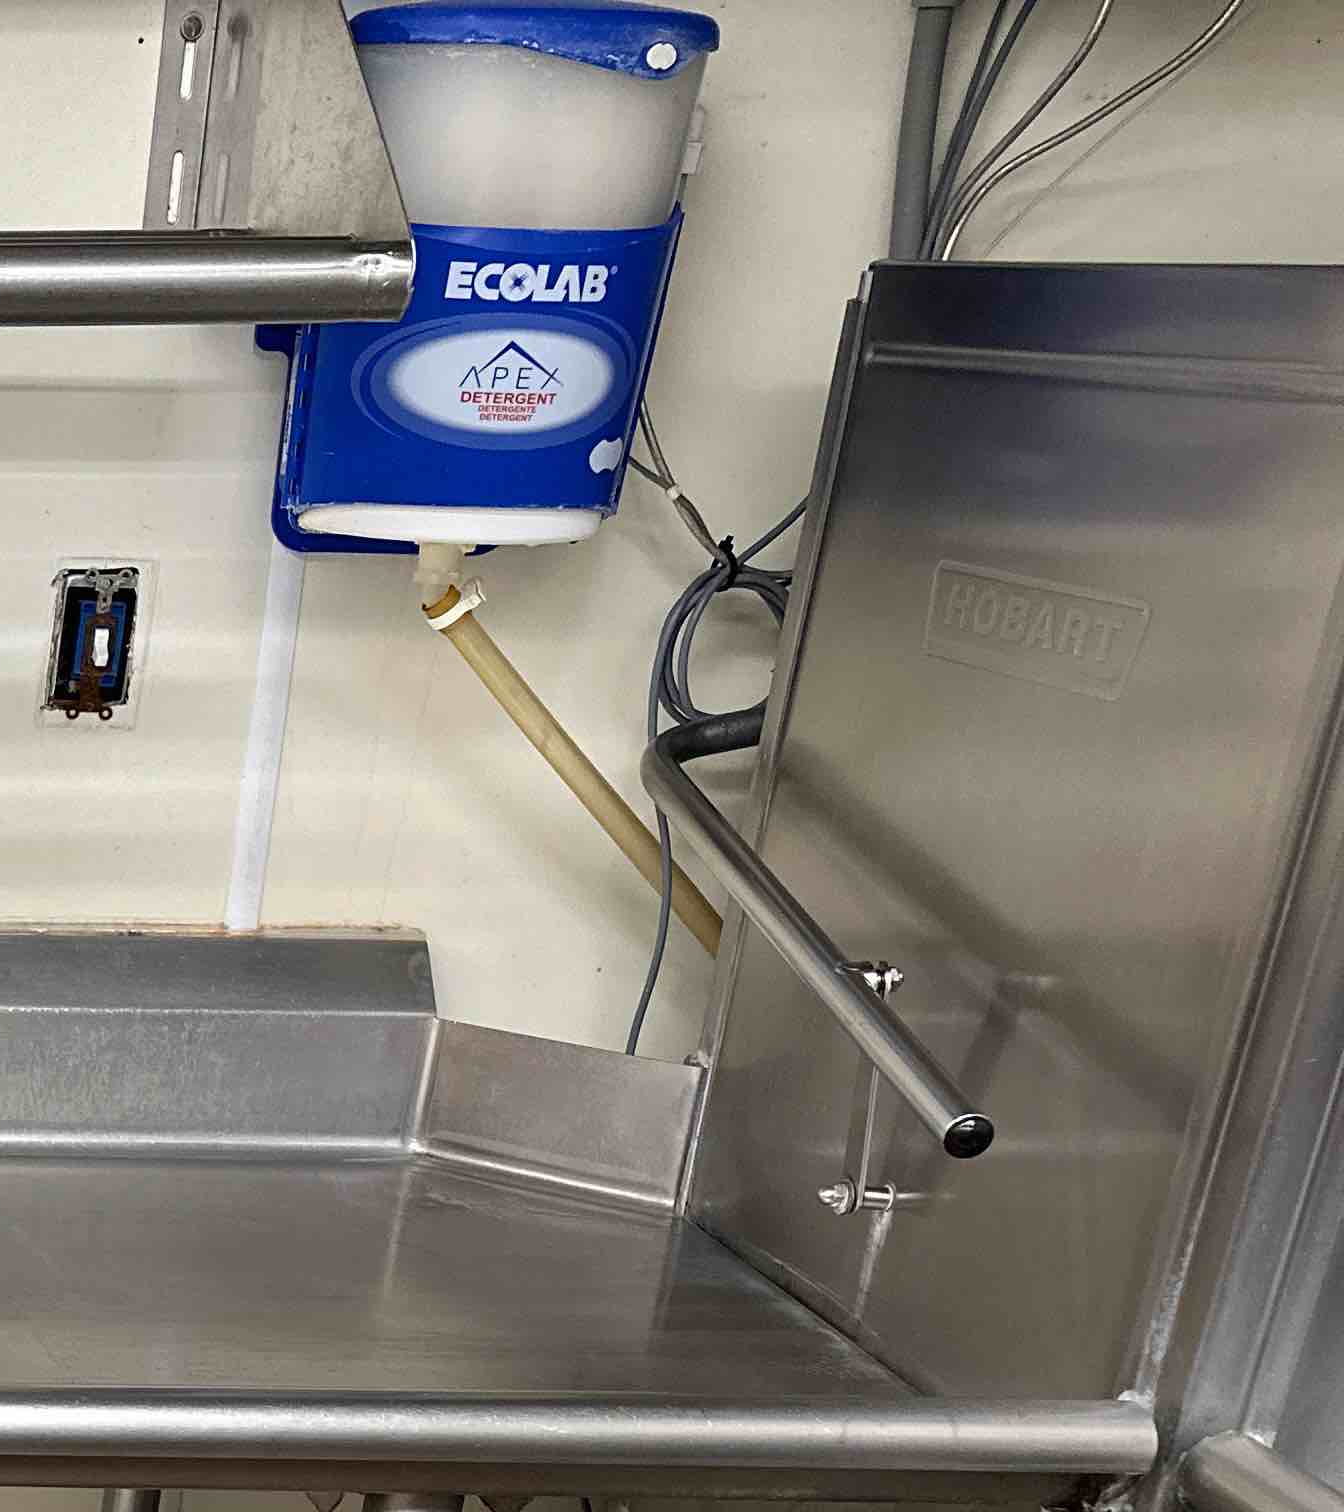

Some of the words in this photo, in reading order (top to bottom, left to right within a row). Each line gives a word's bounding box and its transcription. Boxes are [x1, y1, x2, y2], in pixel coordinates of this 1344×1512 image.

[444, 260, 610, 303] ECOLAB
[459, 365, 563, 390] APEX
[460, 391, 557, 406] DETERGENT
[478, 404, 537, 414] DETERGENTE
[479, 412, 534, 422] DETERGENT
[942, 579, 1125, 664] HOBART
